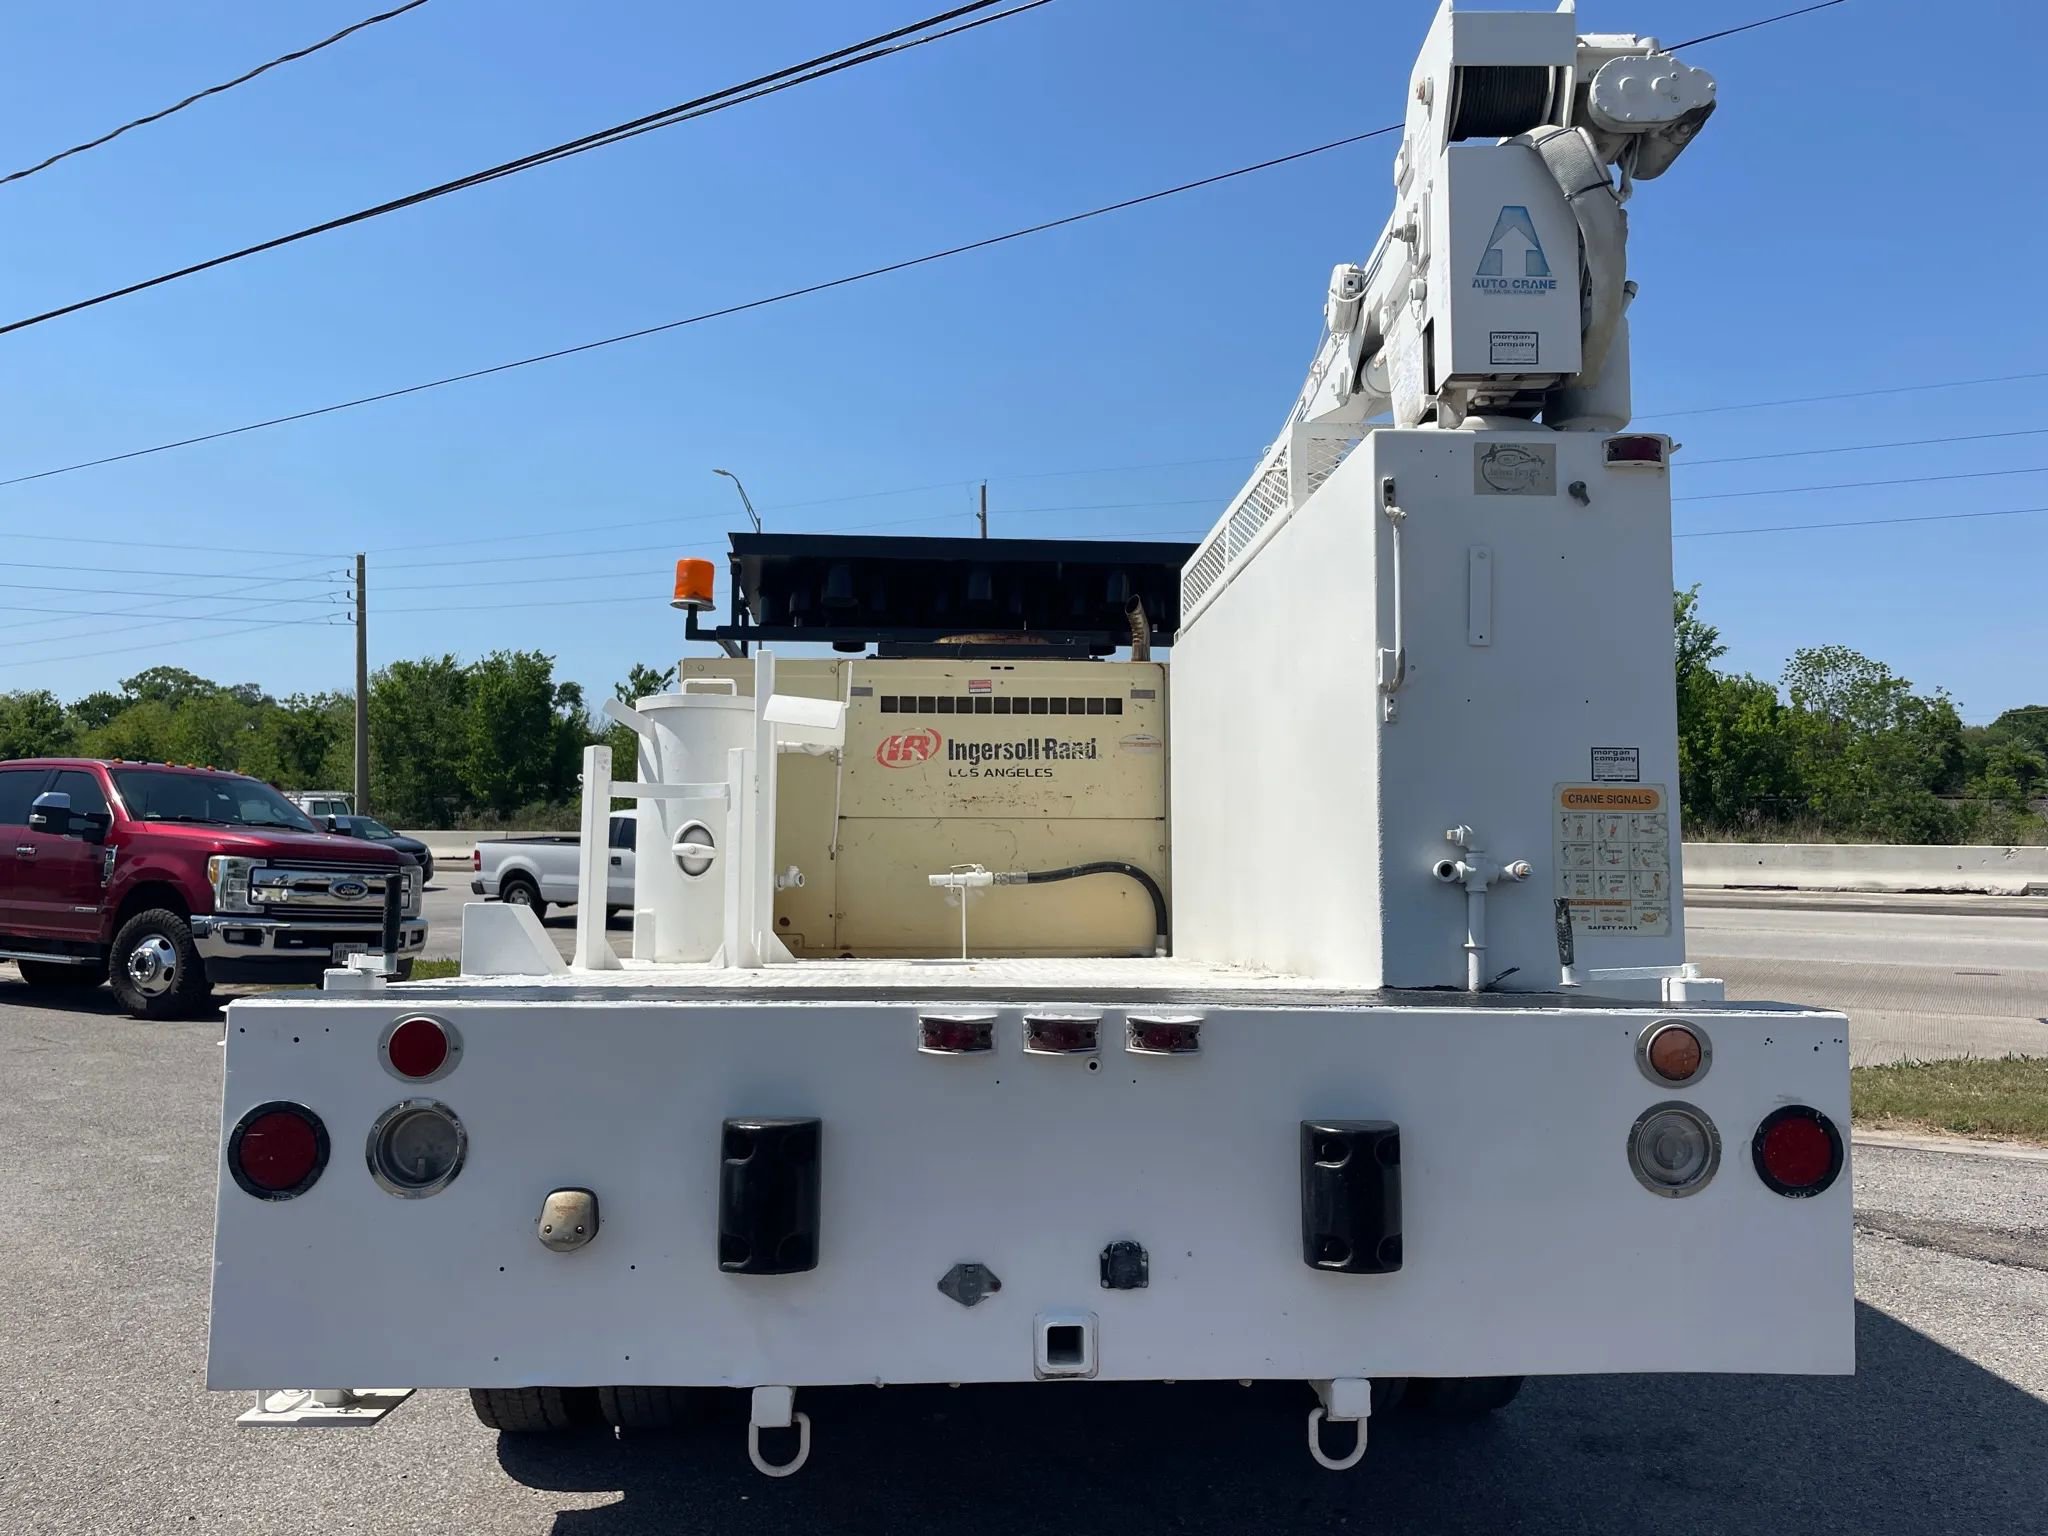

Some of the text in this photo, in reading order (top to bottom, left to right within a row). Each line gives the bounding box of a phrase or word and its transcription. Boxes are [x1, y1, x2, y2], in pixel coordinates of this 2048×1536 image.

[1472, 279, 1557, 290] AUTO CRANE
[983, 768, 1053, 778] ANGELES
[1568, 794, 1652, 804] CRANE SIGNALS
[340, 885, 361, 896] Ford
